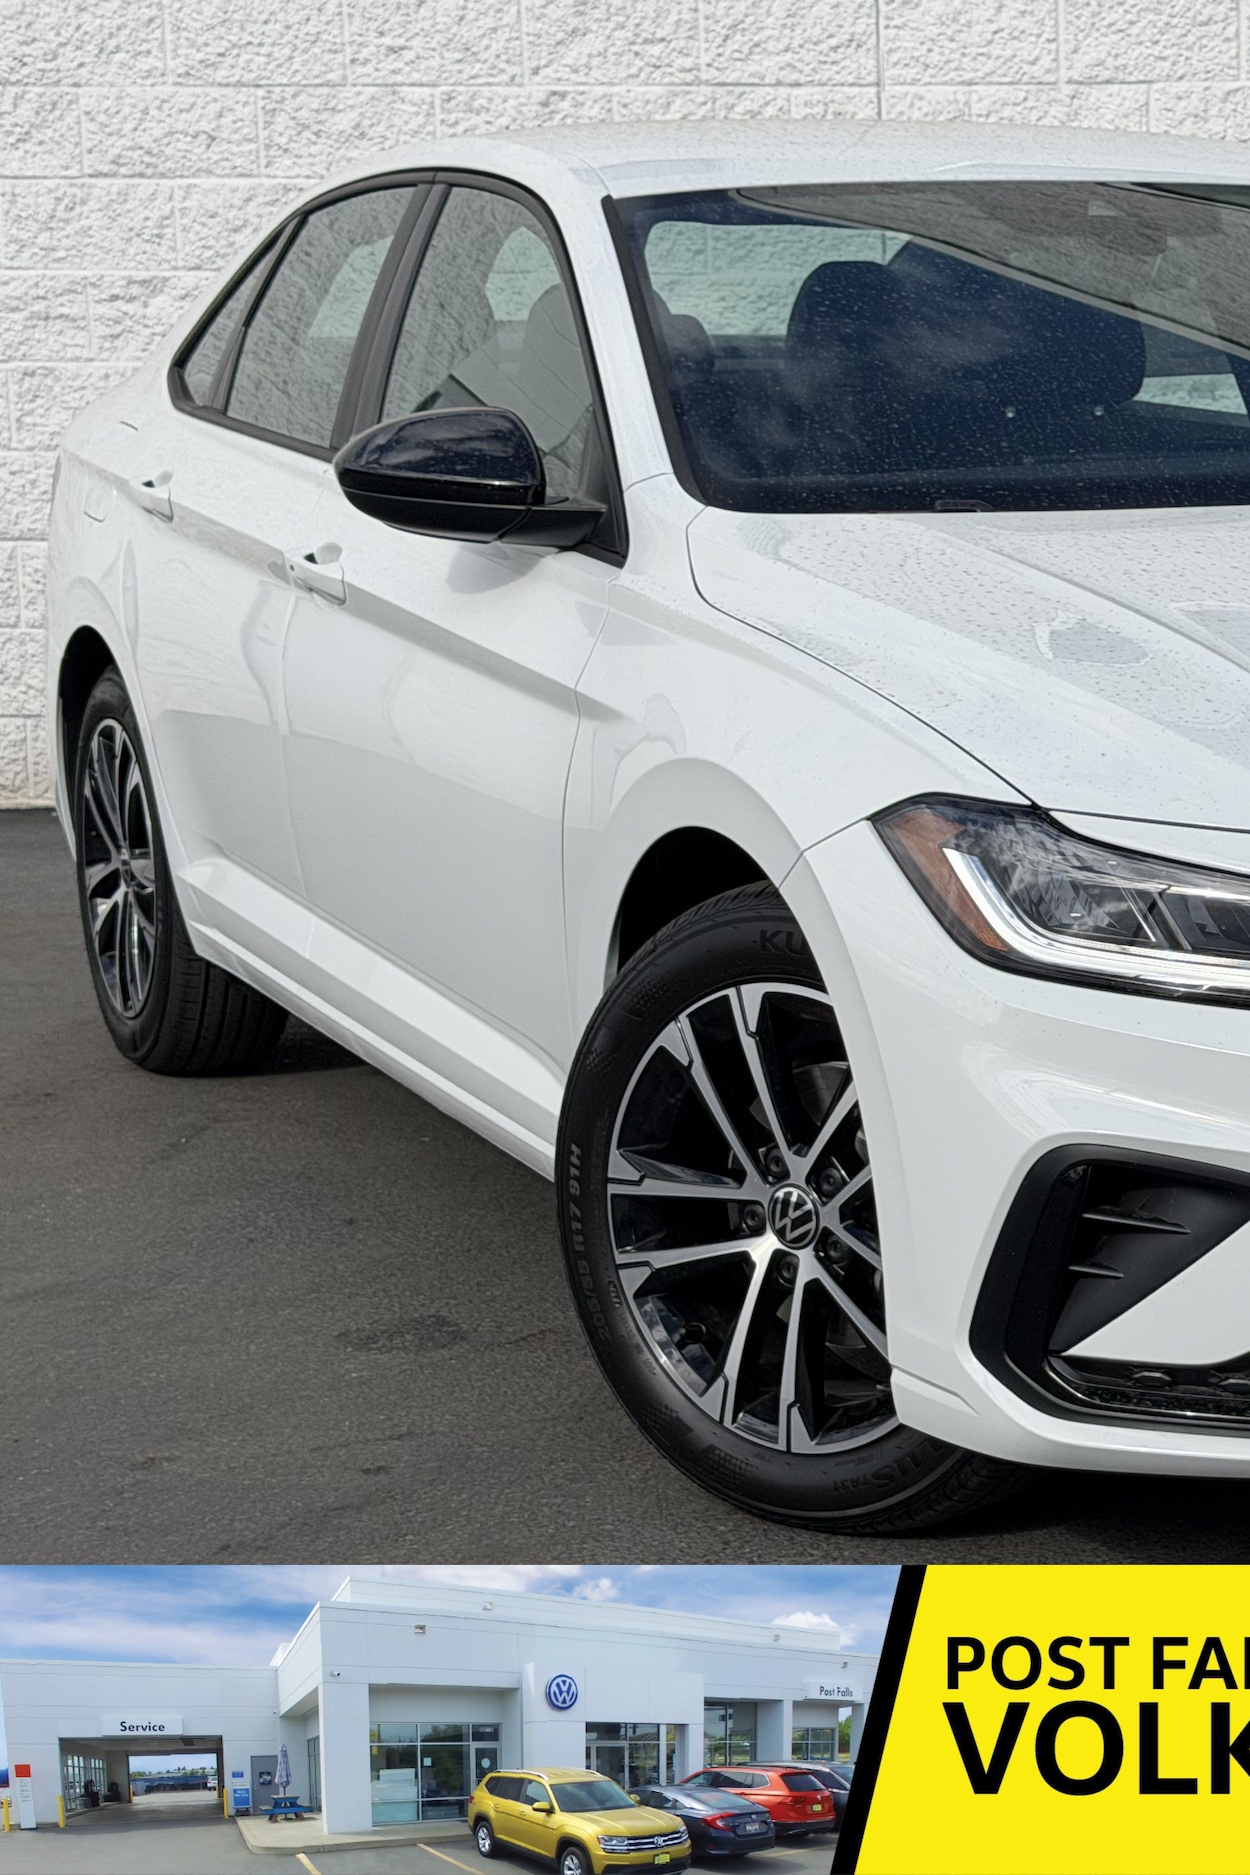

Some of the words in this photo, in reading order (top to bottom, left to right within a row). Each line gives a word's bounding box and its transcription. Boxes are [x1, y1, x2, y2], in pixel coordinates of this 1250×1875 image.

[760, 930, 810, 959] KU
[568, 1143, 583, 1197] 91H
[568, 1202, 585, 1252] R17
[819, 1685, 835, 1697] Post
[836, 1686, 854, 1698] Falls
[119, 1720, 166, 1733] Service
